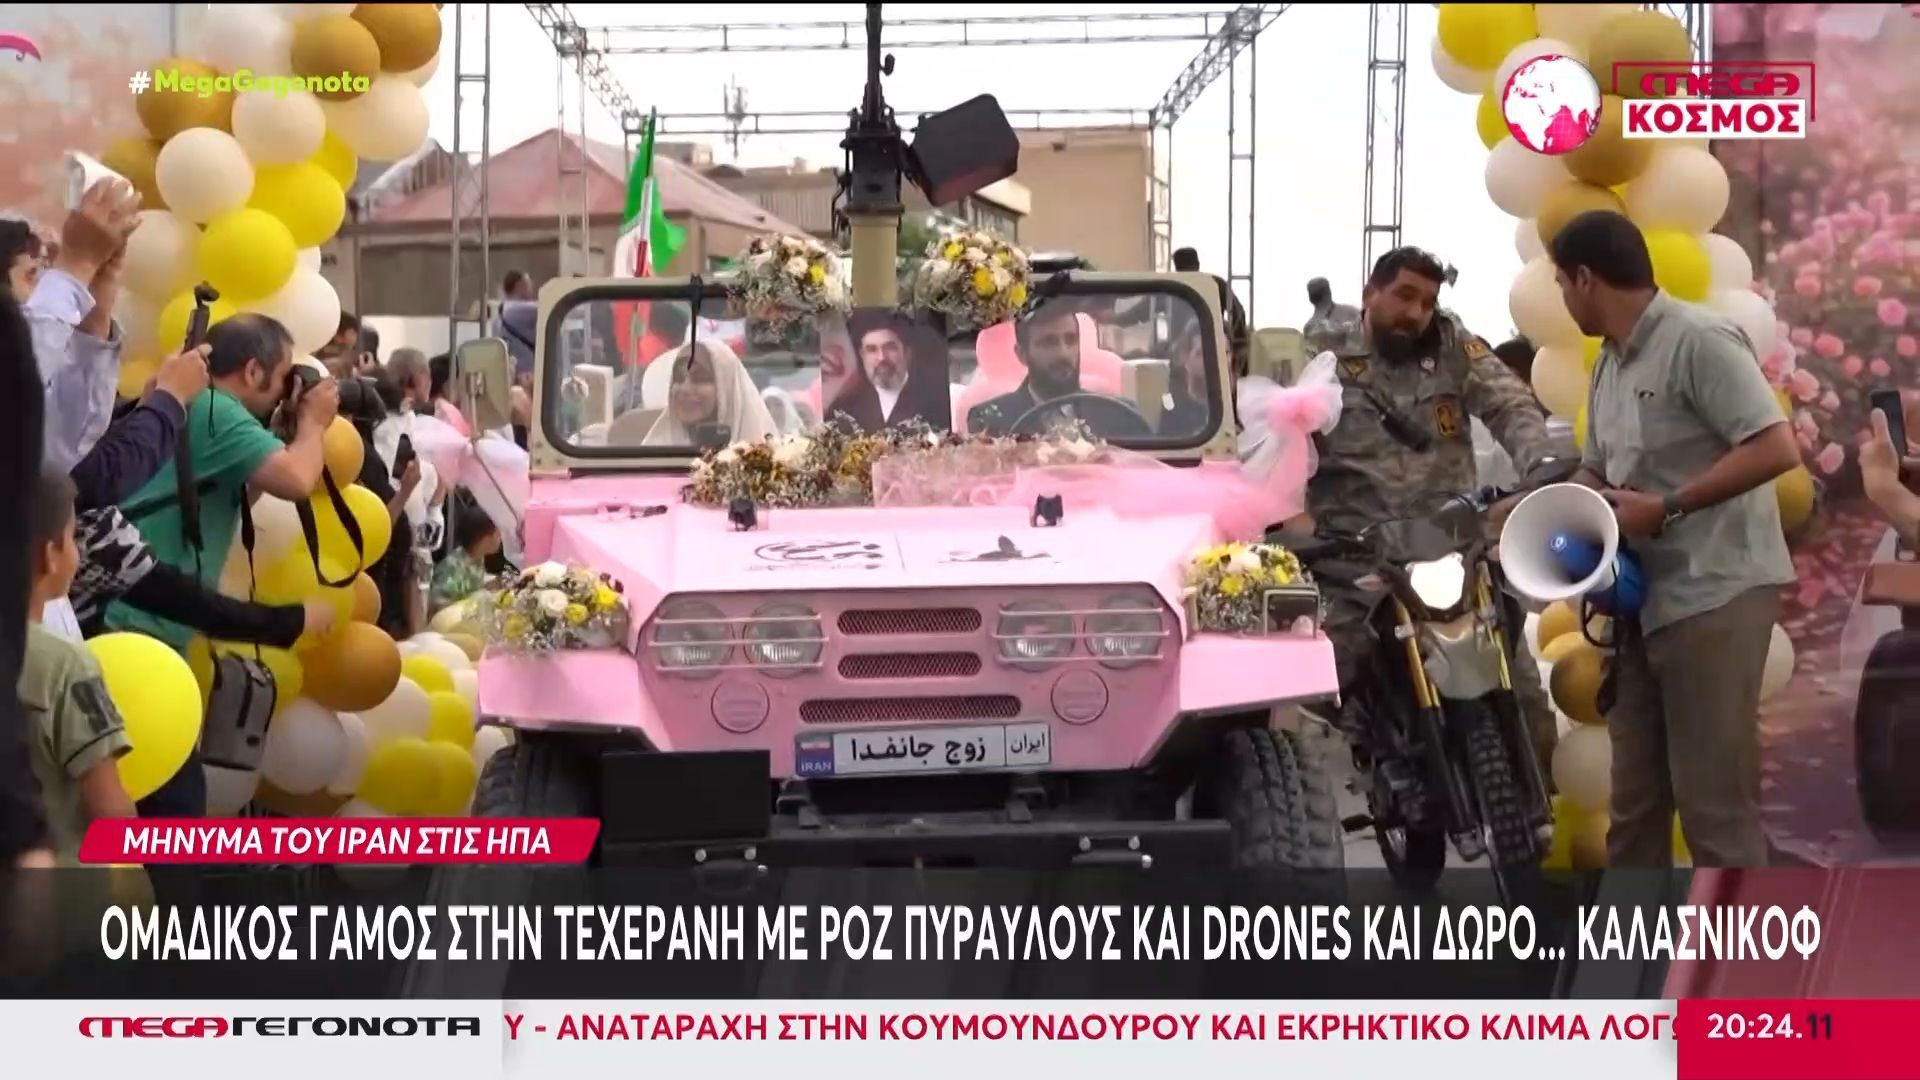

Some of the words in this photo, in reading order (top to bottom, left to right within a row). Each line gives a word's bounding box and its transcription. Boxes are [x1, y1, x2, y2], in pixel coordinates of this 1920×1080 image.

[851, 734, 935, 765] جانفدا
[945, 737, 986, 765] زوج
[1010, 732, 1046, 754] ایران
[801, 760, 832, 772] IRAN
